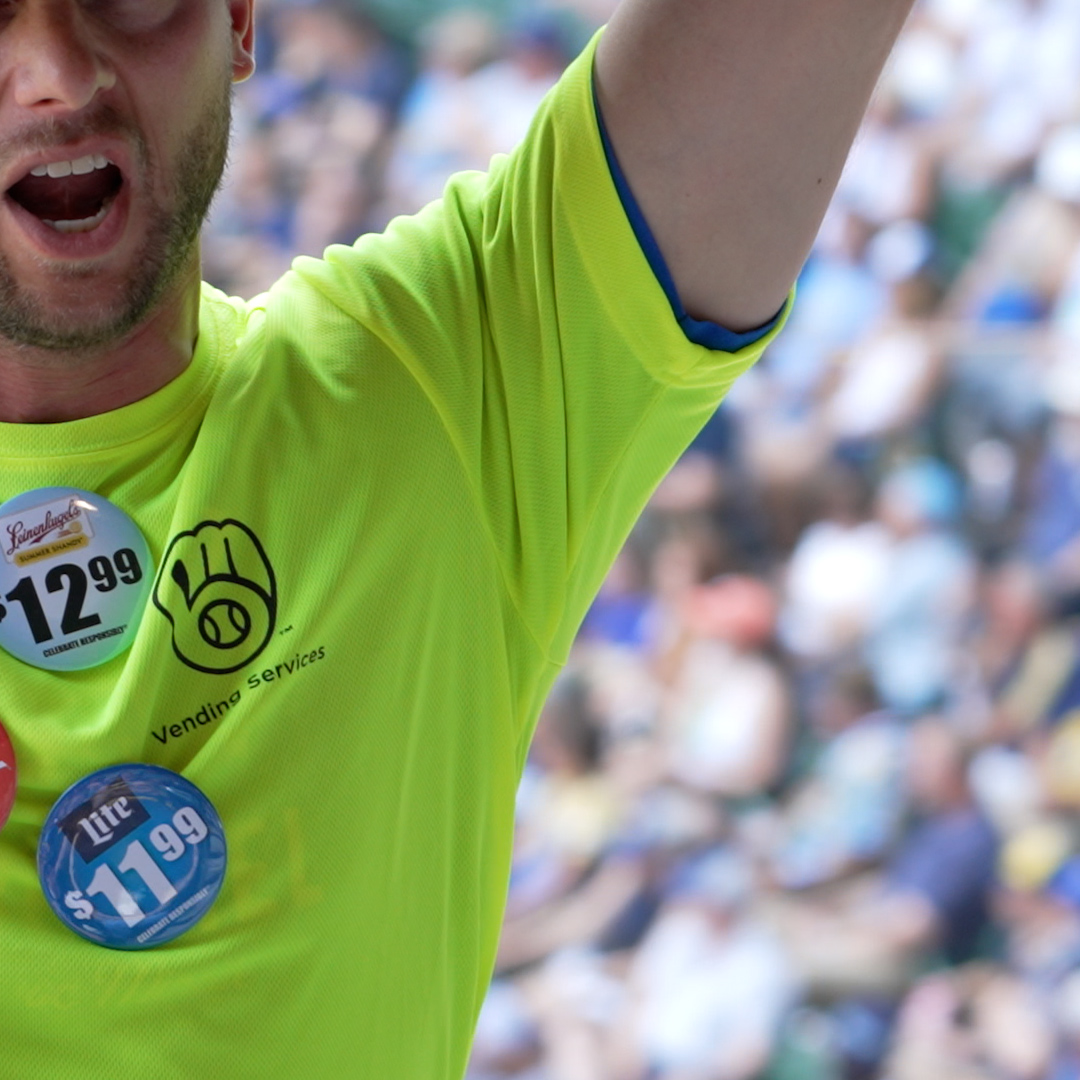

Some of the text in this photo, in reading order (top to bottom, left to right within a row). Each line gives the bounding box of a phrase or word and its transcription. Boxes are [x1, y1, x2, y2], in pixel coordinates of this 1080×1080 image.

[19, 547, 51, 563] SUMMER
[151, 691, 242, 746] Vending
[77, 796, 134, 847] Lite
